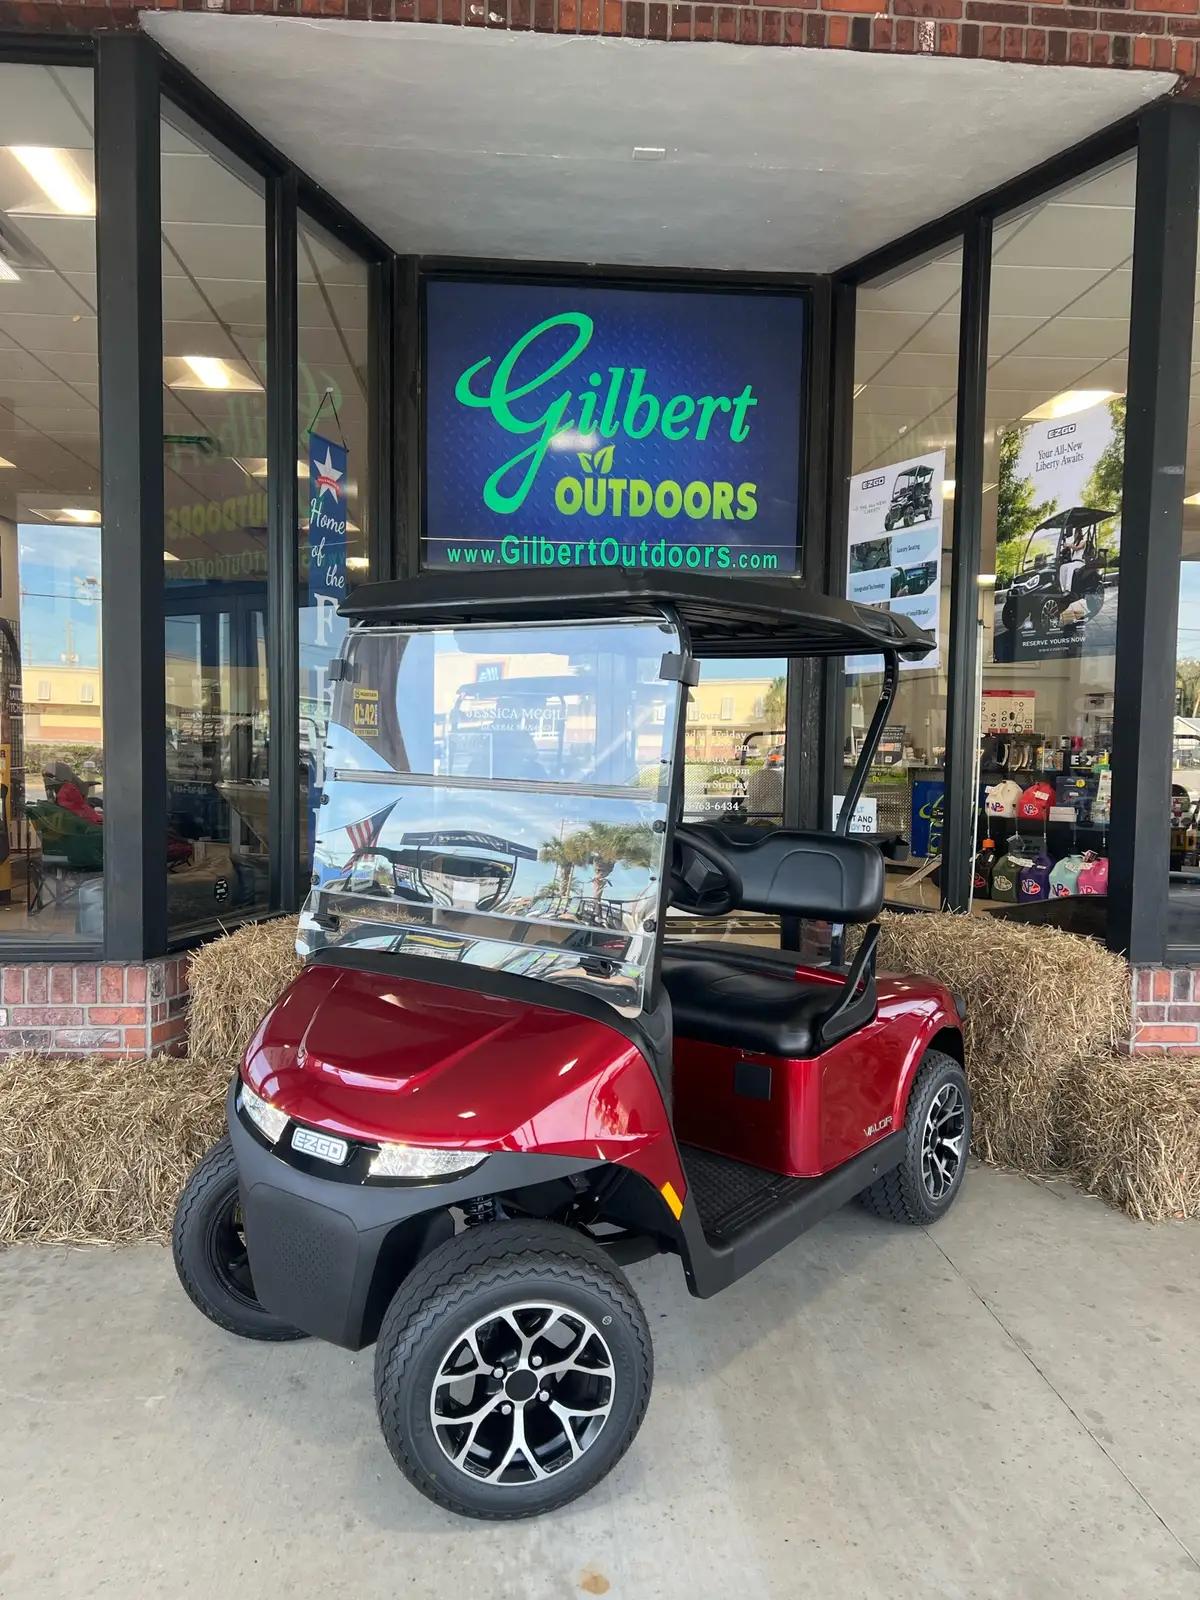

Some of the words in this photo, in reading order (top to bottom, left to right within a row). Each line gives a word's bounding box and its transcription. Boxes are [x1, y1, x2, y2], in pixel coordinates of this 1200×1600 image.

[455, 312, 758, 514] Gilbert
[1047, 424, 1077, 439] EZGO
[1038, 450, 1053, 460] Your
[1054, 442, 1083, 456] All-New
[1035, 459, 1060, 472] Liberty
[1061, 452, 1084, 466] Awaits
[862, 476, 885, 490] EZGO
[555, 476, 758, 521] OUTDOORS
[310, 498, 346, 535] Home
[311, 537, 325, 566] of
[447, 535, 779, 569] www.GilbertOutdoors.com
[326, 564, 345, 588] the
[1049, 637, 1070, 645] YOURS
[466, 707, 518, 719] JESSICA
[715, 730, 747, 740] Friday
[712, 780, 749, 791] Sunday
[857, 815, 873, 823] AND
[863, 1115, 893, 1137] VALOR
[292, 1128, 347, 1164] EZGO
